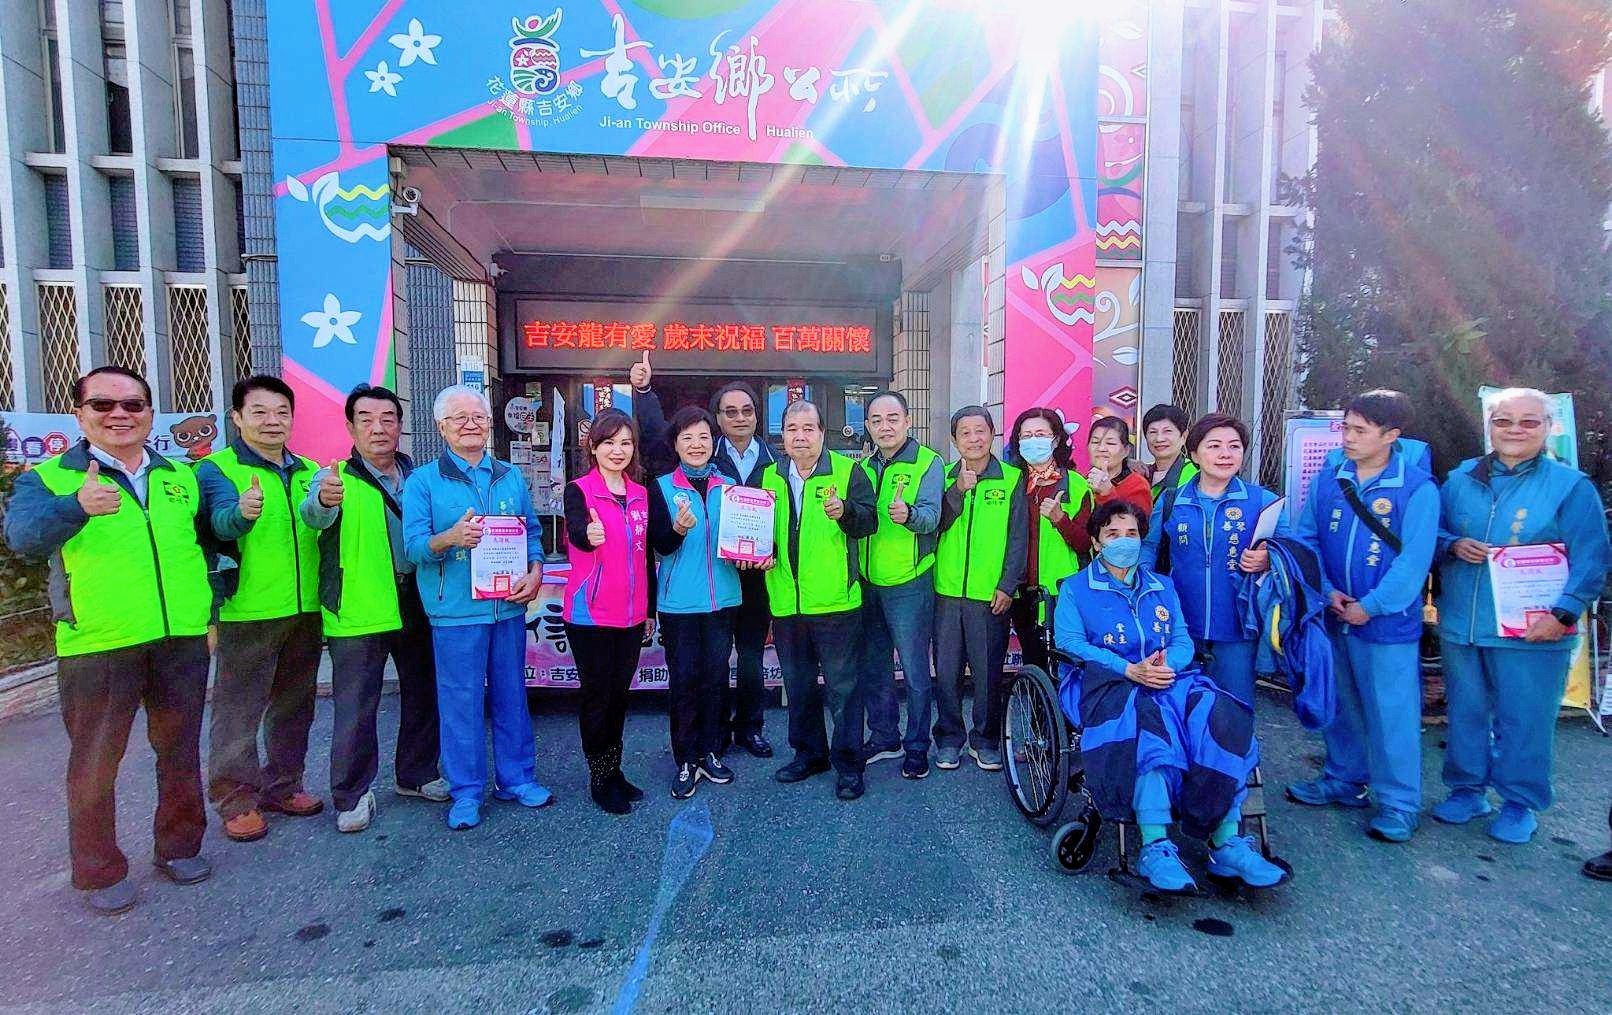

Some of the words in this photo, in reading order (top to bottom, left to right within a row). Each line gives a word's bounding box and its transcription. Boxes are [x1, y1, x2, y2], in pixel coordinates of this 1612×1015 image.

[579, 13, 889, 141] 吉安鄉公所
[599, 116, 632, 129] Ji-an
[636, 117, 699, 135] Township
[702, 121, 741, 135] Office
[766, 125, 814, 139] Hualien
[524, 320, 656, 350] 吉安龍有愛
[663, 323, 766, 351] 歲末祝福
[772, 325, 872, 352] 百萬關懷
[638, 667, 668, 683] 捐助
